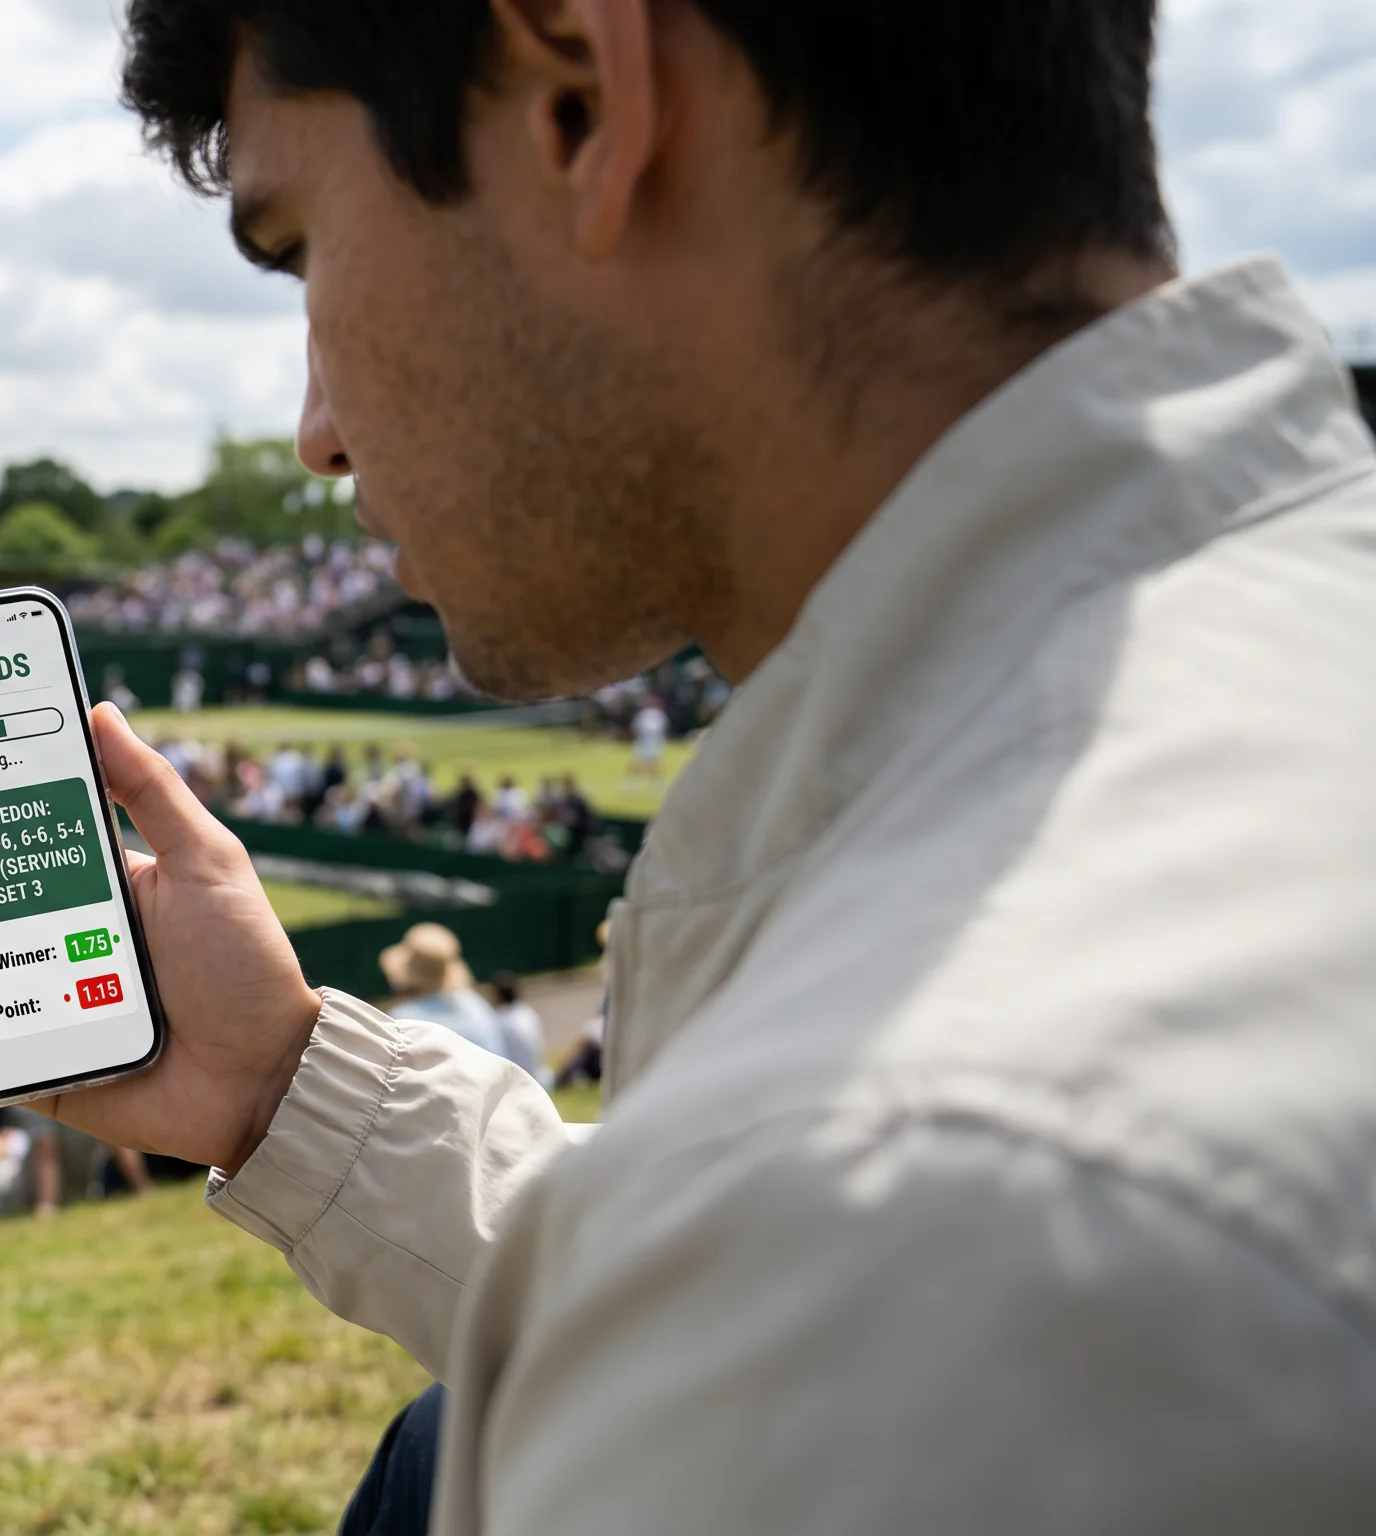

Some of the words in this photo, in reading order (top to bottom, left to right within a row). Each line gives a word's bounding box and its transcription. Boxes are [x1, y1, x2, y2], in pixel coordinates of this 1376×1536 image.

[21, 826, 54, 846] 6-6,
[57, 819, 85, 840] 5-4
[0, 845, 87, 881] (SERVING)
[32, 879, 43, 897] 3
[71, 933, 108, 956] 1.75
[82, 980, 118, 1002] 1.15
